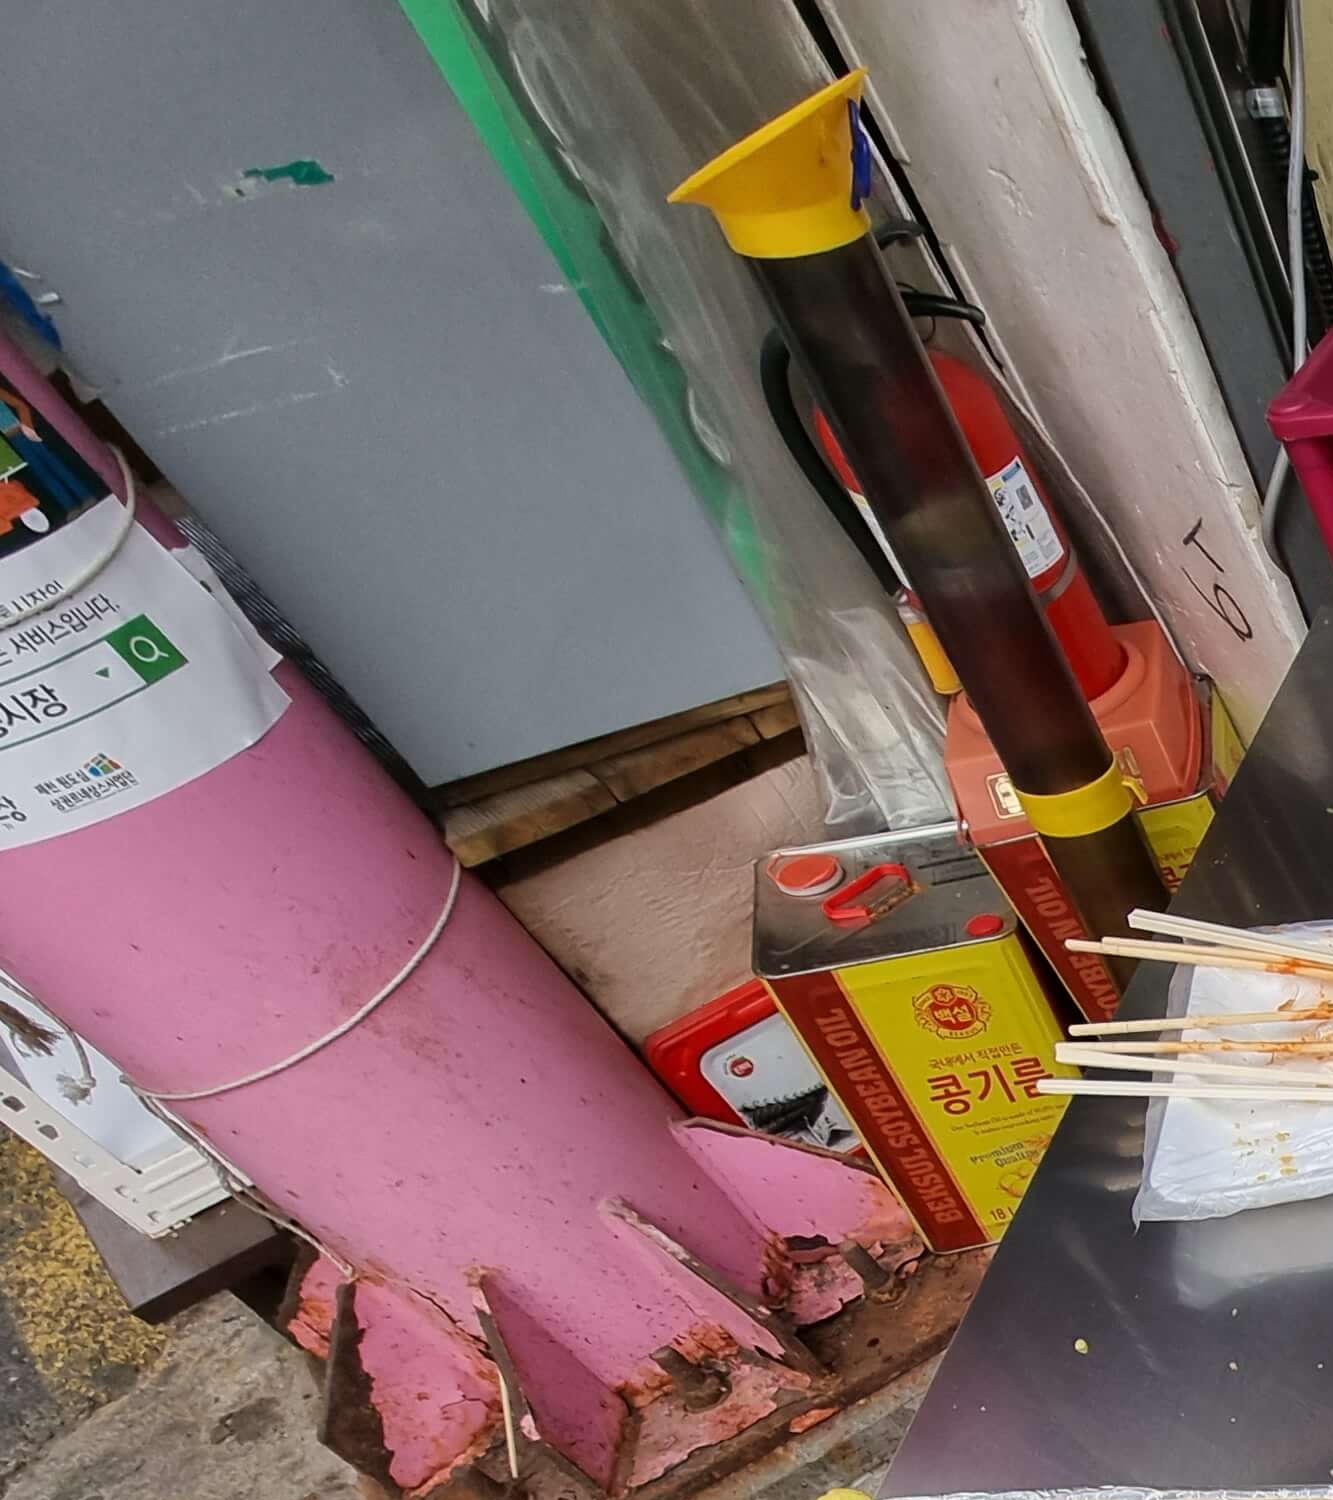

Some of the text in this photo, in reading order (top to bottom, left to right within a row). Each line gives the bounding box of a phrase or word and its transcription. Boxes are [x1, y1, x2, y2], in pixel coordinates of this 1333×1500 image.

[9, 592, 121, 655] 서비스입니다.
[0, 684, 69, 740] 시장
[927, 1056, 1054, 1115] 콩기름
[815, 1007, 965, 1226] BEKSUL SOYBEAN OIL
